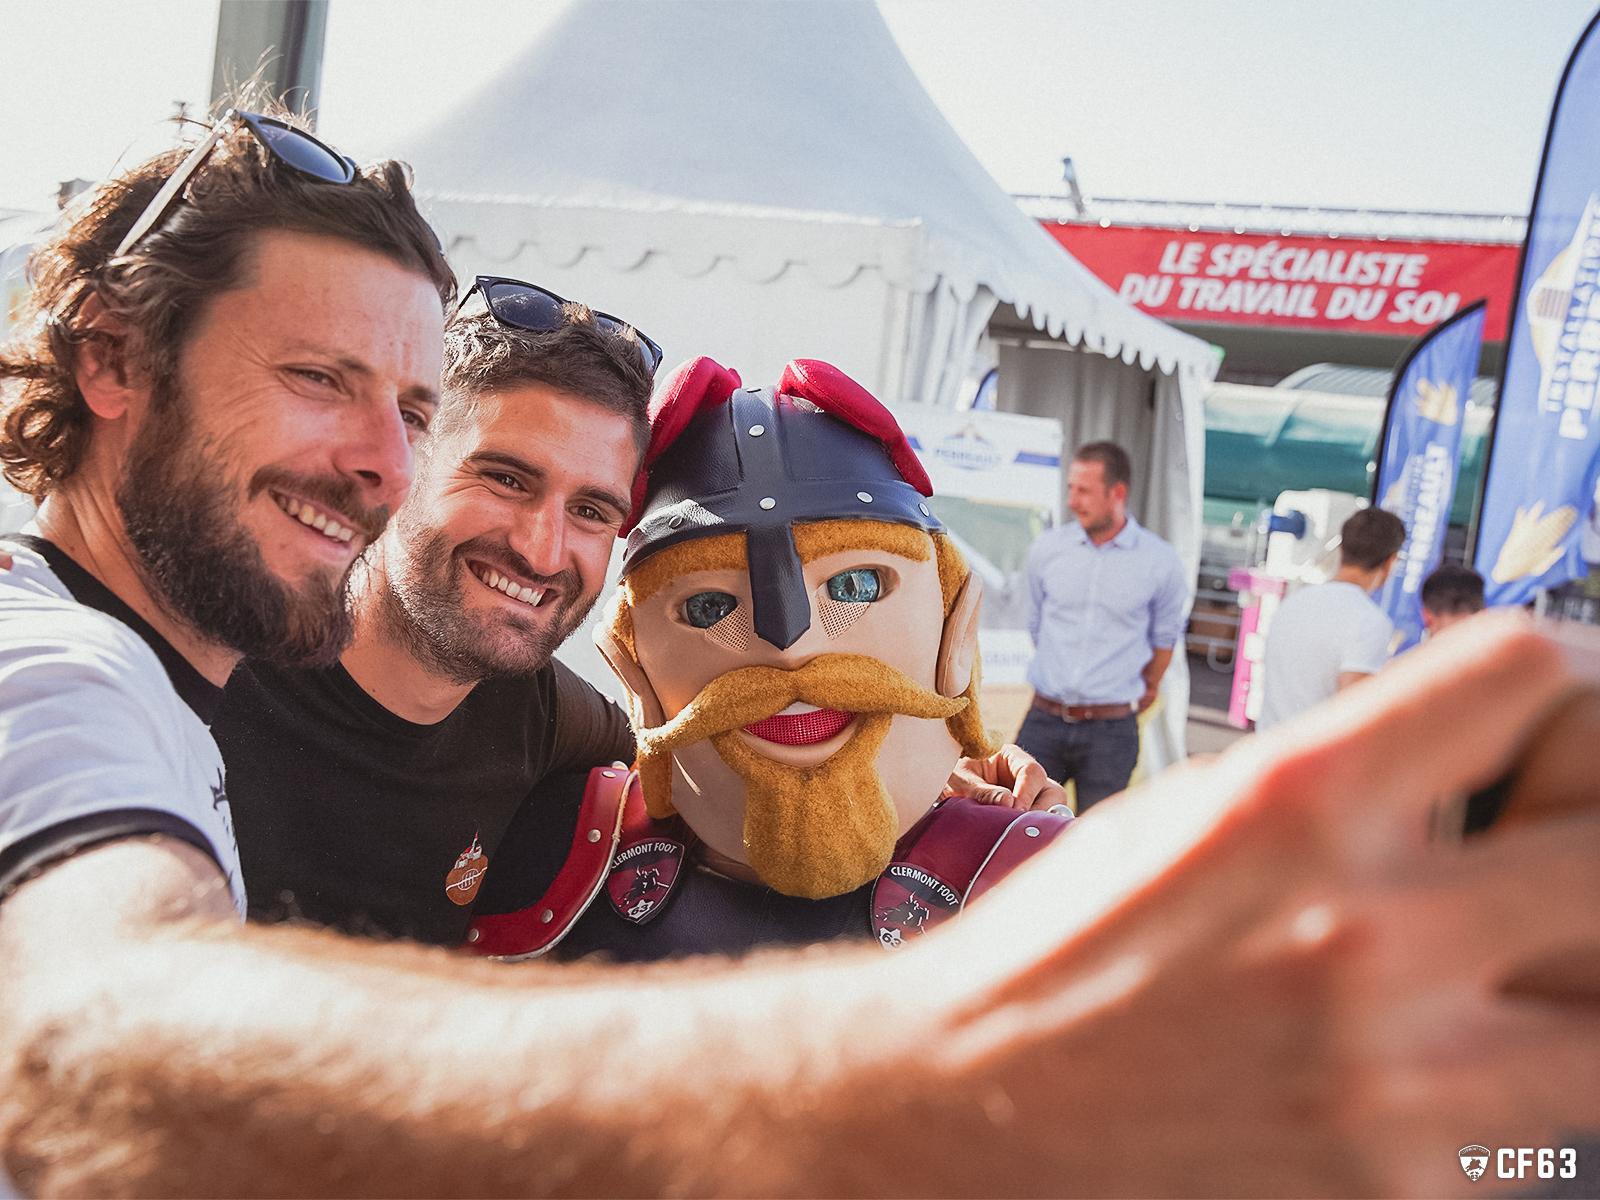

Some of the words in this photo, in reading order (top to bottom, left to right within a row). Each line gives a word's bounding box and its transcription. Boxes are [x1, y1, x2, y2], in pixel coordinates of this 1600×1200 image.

[1158, 241, 1206, 275] LE
[1205, 240, 1430, 288] SPÉCIALISTE
[1119, 273, 1174, 308] DU
[1177, 276, 1318, 319] TRAVAIL
[1324, 286, 1389, 322] DU
[654, 842, 678, 854] FOOT
[890, 866, 940, 890] CLERMONT
[937, 884, 959, 906] FOOT
[631, 904, 649, 916] 63
[882, 932, 902, 949] 63
